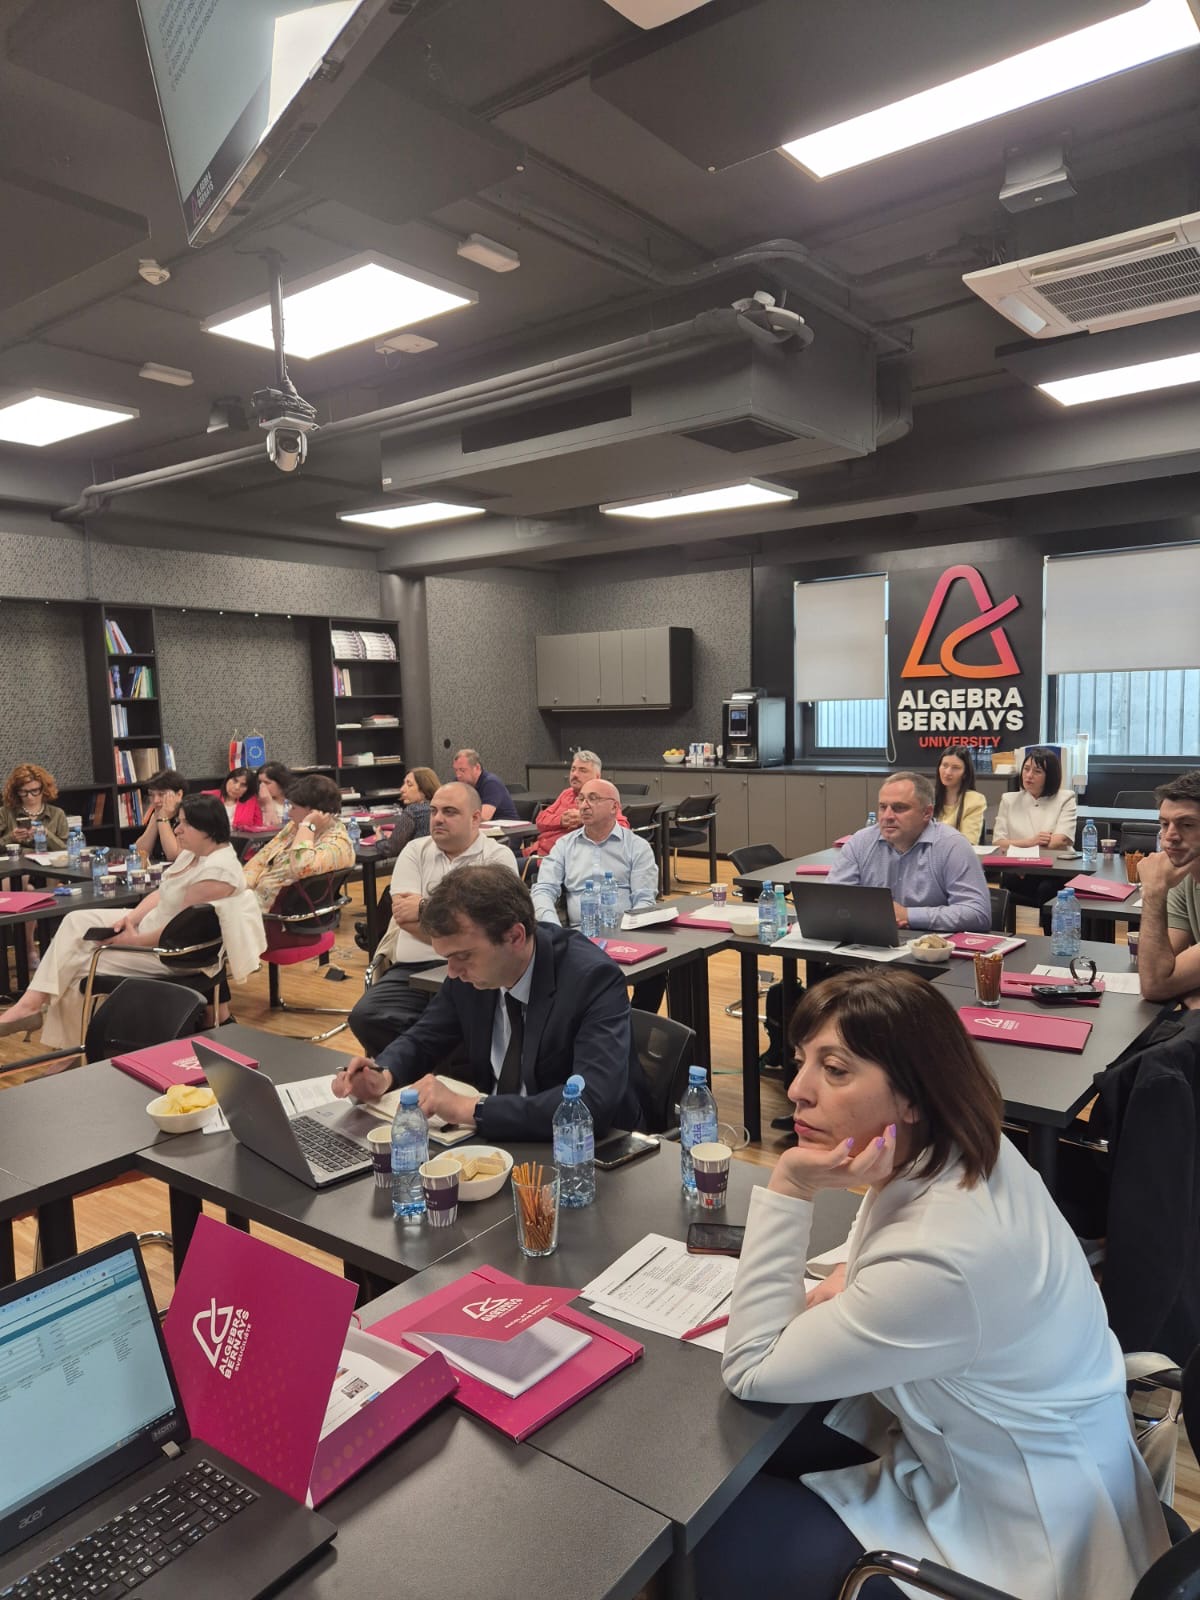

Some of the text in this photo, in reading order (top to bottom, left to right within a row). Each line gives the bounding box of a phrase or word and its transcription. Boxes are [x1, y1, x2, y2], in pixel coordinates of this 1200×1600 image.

[897, 687, 1024, 710] ALGEBRA
[897, 709, 1024, 732] BERNAYS
[919, 735, 1001, 748] UNIVERSITY
[218, 1308, 244, 1376] ALGEBRA
[224, 1310, 250, 1380] BERNAYS
[18, 1506, 46, 1529] acer
